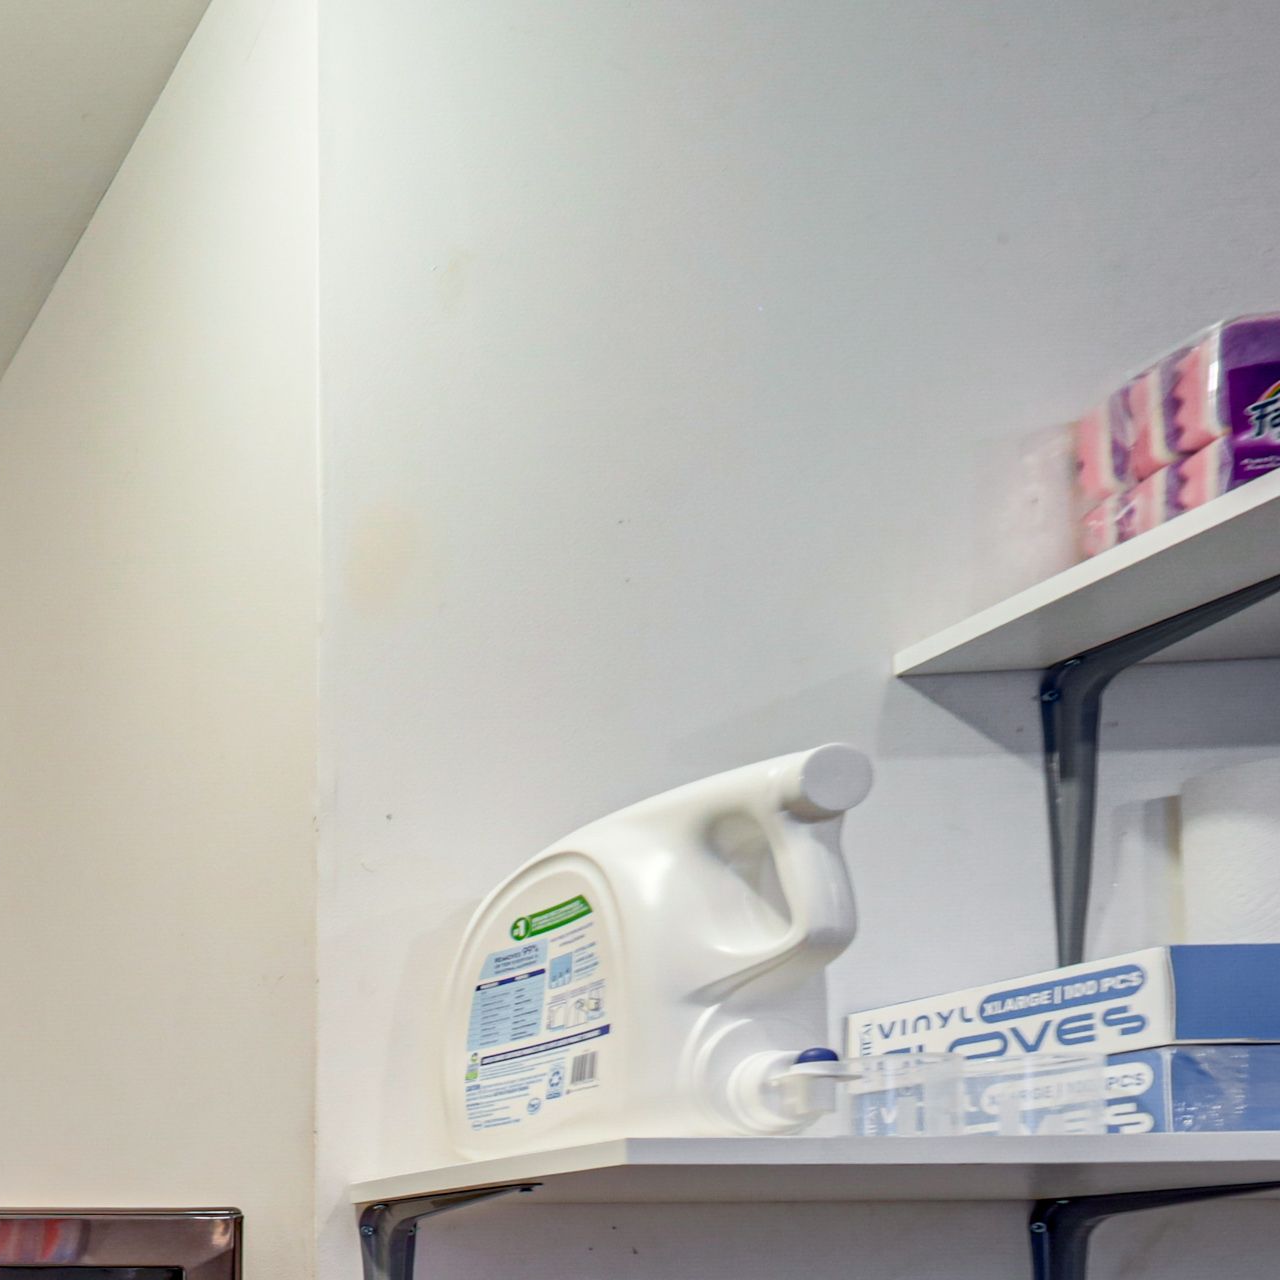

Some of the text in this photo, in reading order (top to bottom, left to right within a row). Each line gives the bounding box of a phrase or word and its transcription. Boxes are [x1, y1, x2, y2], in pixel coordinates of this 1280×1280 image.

[981, 990, 1052, 1017] XLARGE
[1063, 980, 1097, 1001] 100
[1099, 971, 1143, 994] PCS
[1106, 1072, 1145, 1091] PCS
